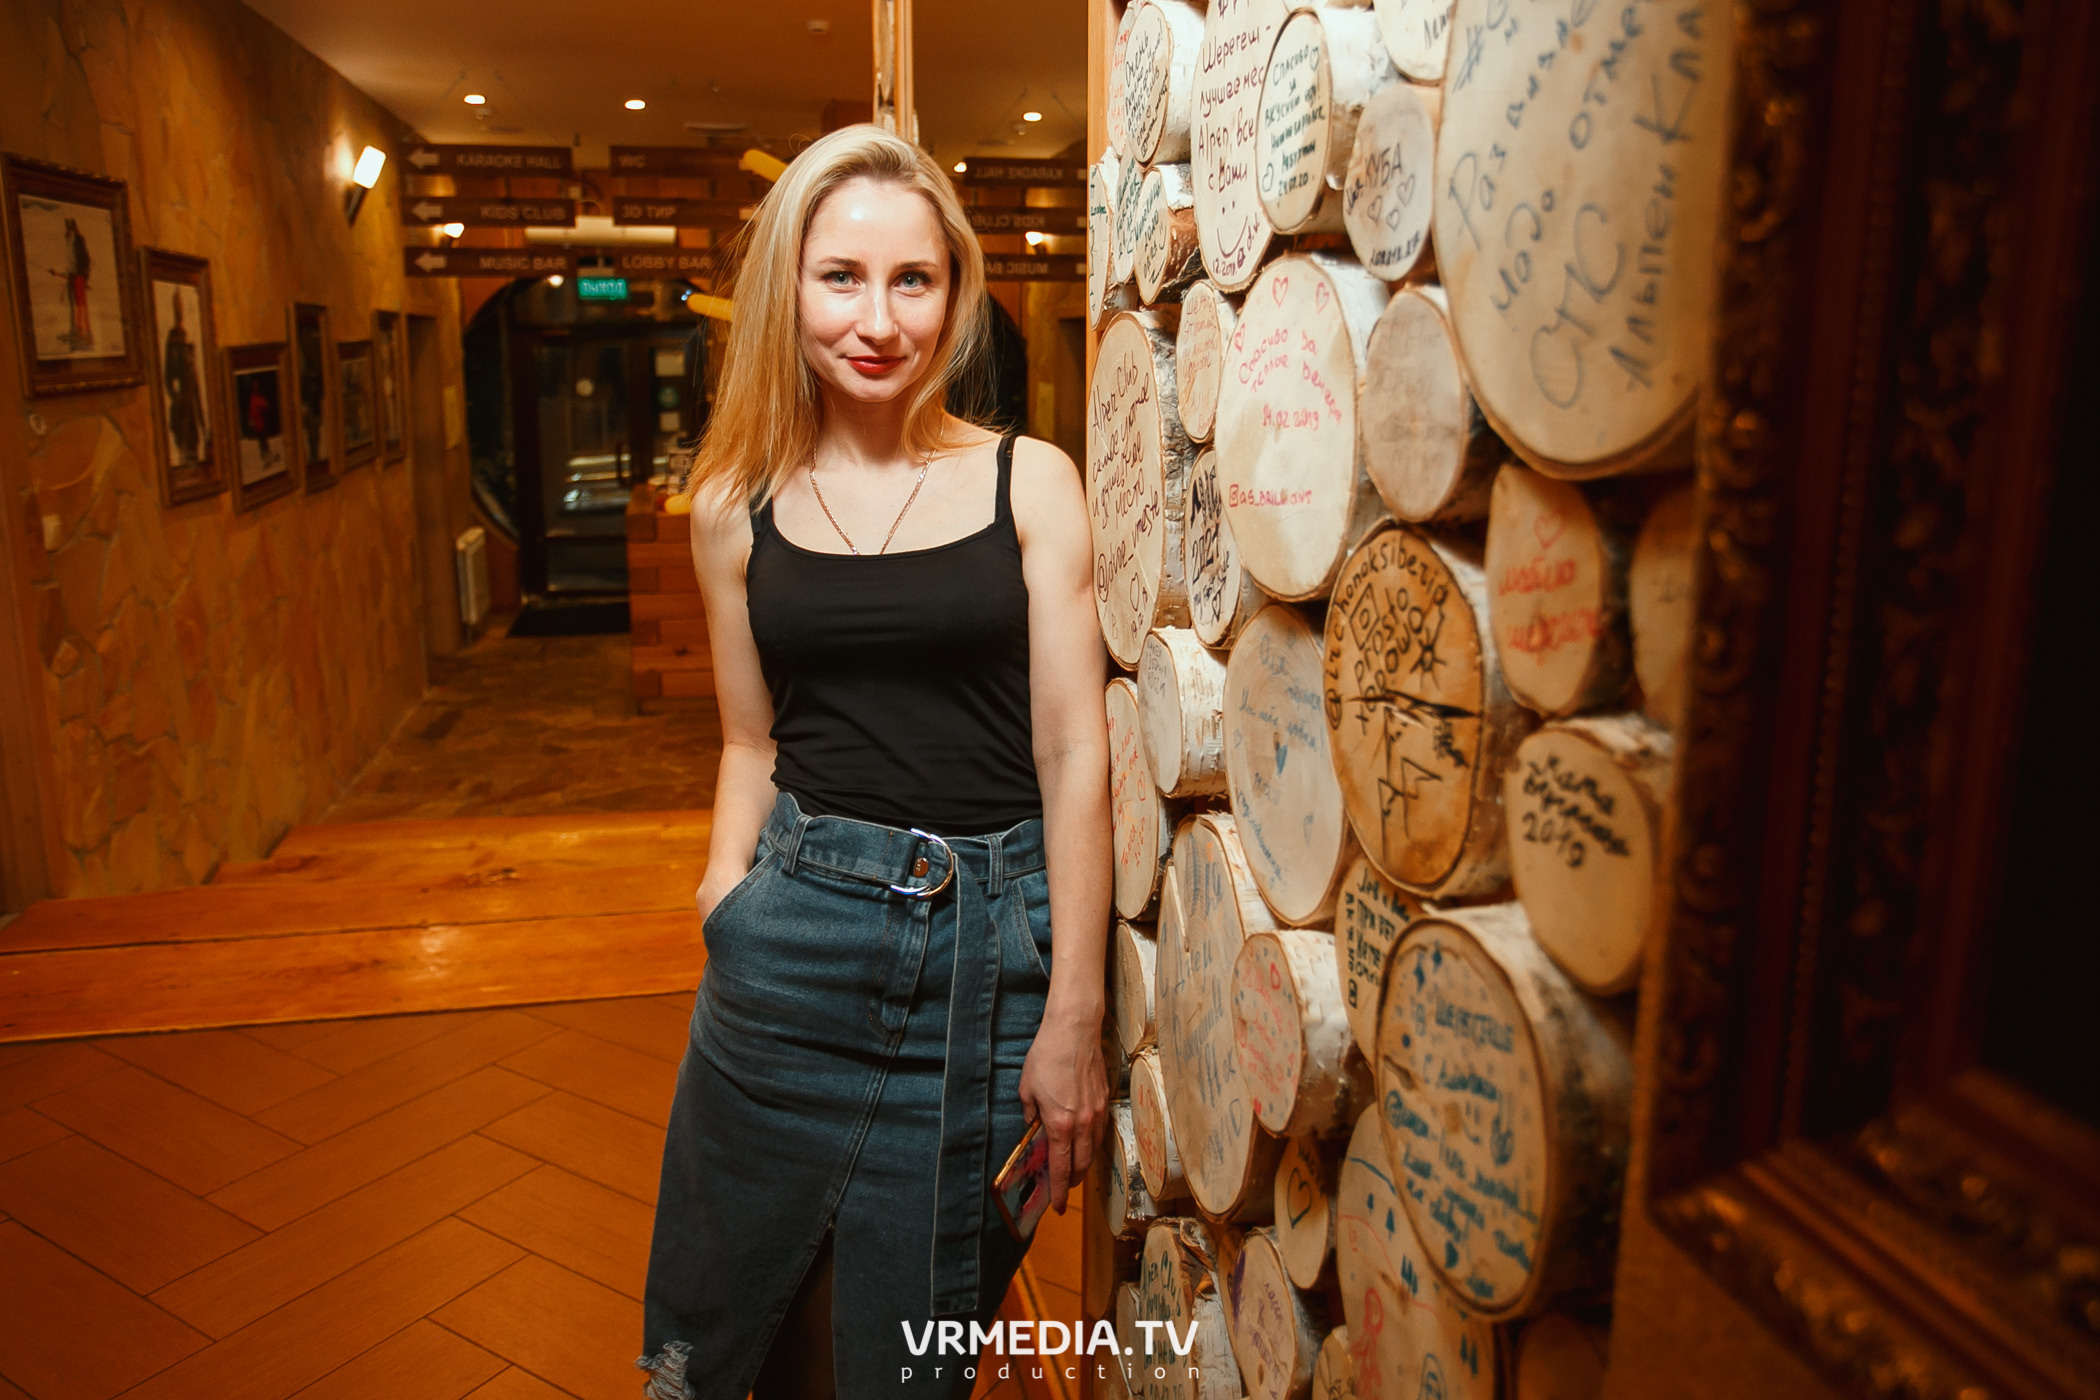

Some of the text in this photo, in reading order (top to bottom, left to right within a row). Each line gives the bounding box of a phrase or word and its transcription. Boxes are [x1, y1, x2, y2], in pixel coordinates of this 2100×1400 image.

[1203, 27, 1260, 73] Шерегеш
[1244, 65, 1264, 90] мес
[456, 153, 562, 169] KARAOKE HALL
[619, 154, 647, 169] WC
[480, 203, 567, 221] KIDS CLUB
[479, 255, 568, 271] MUSIC BAR
[622, 255, 676, 270] LOBBY
[1239, 328, 1288, 384] Спасибо
